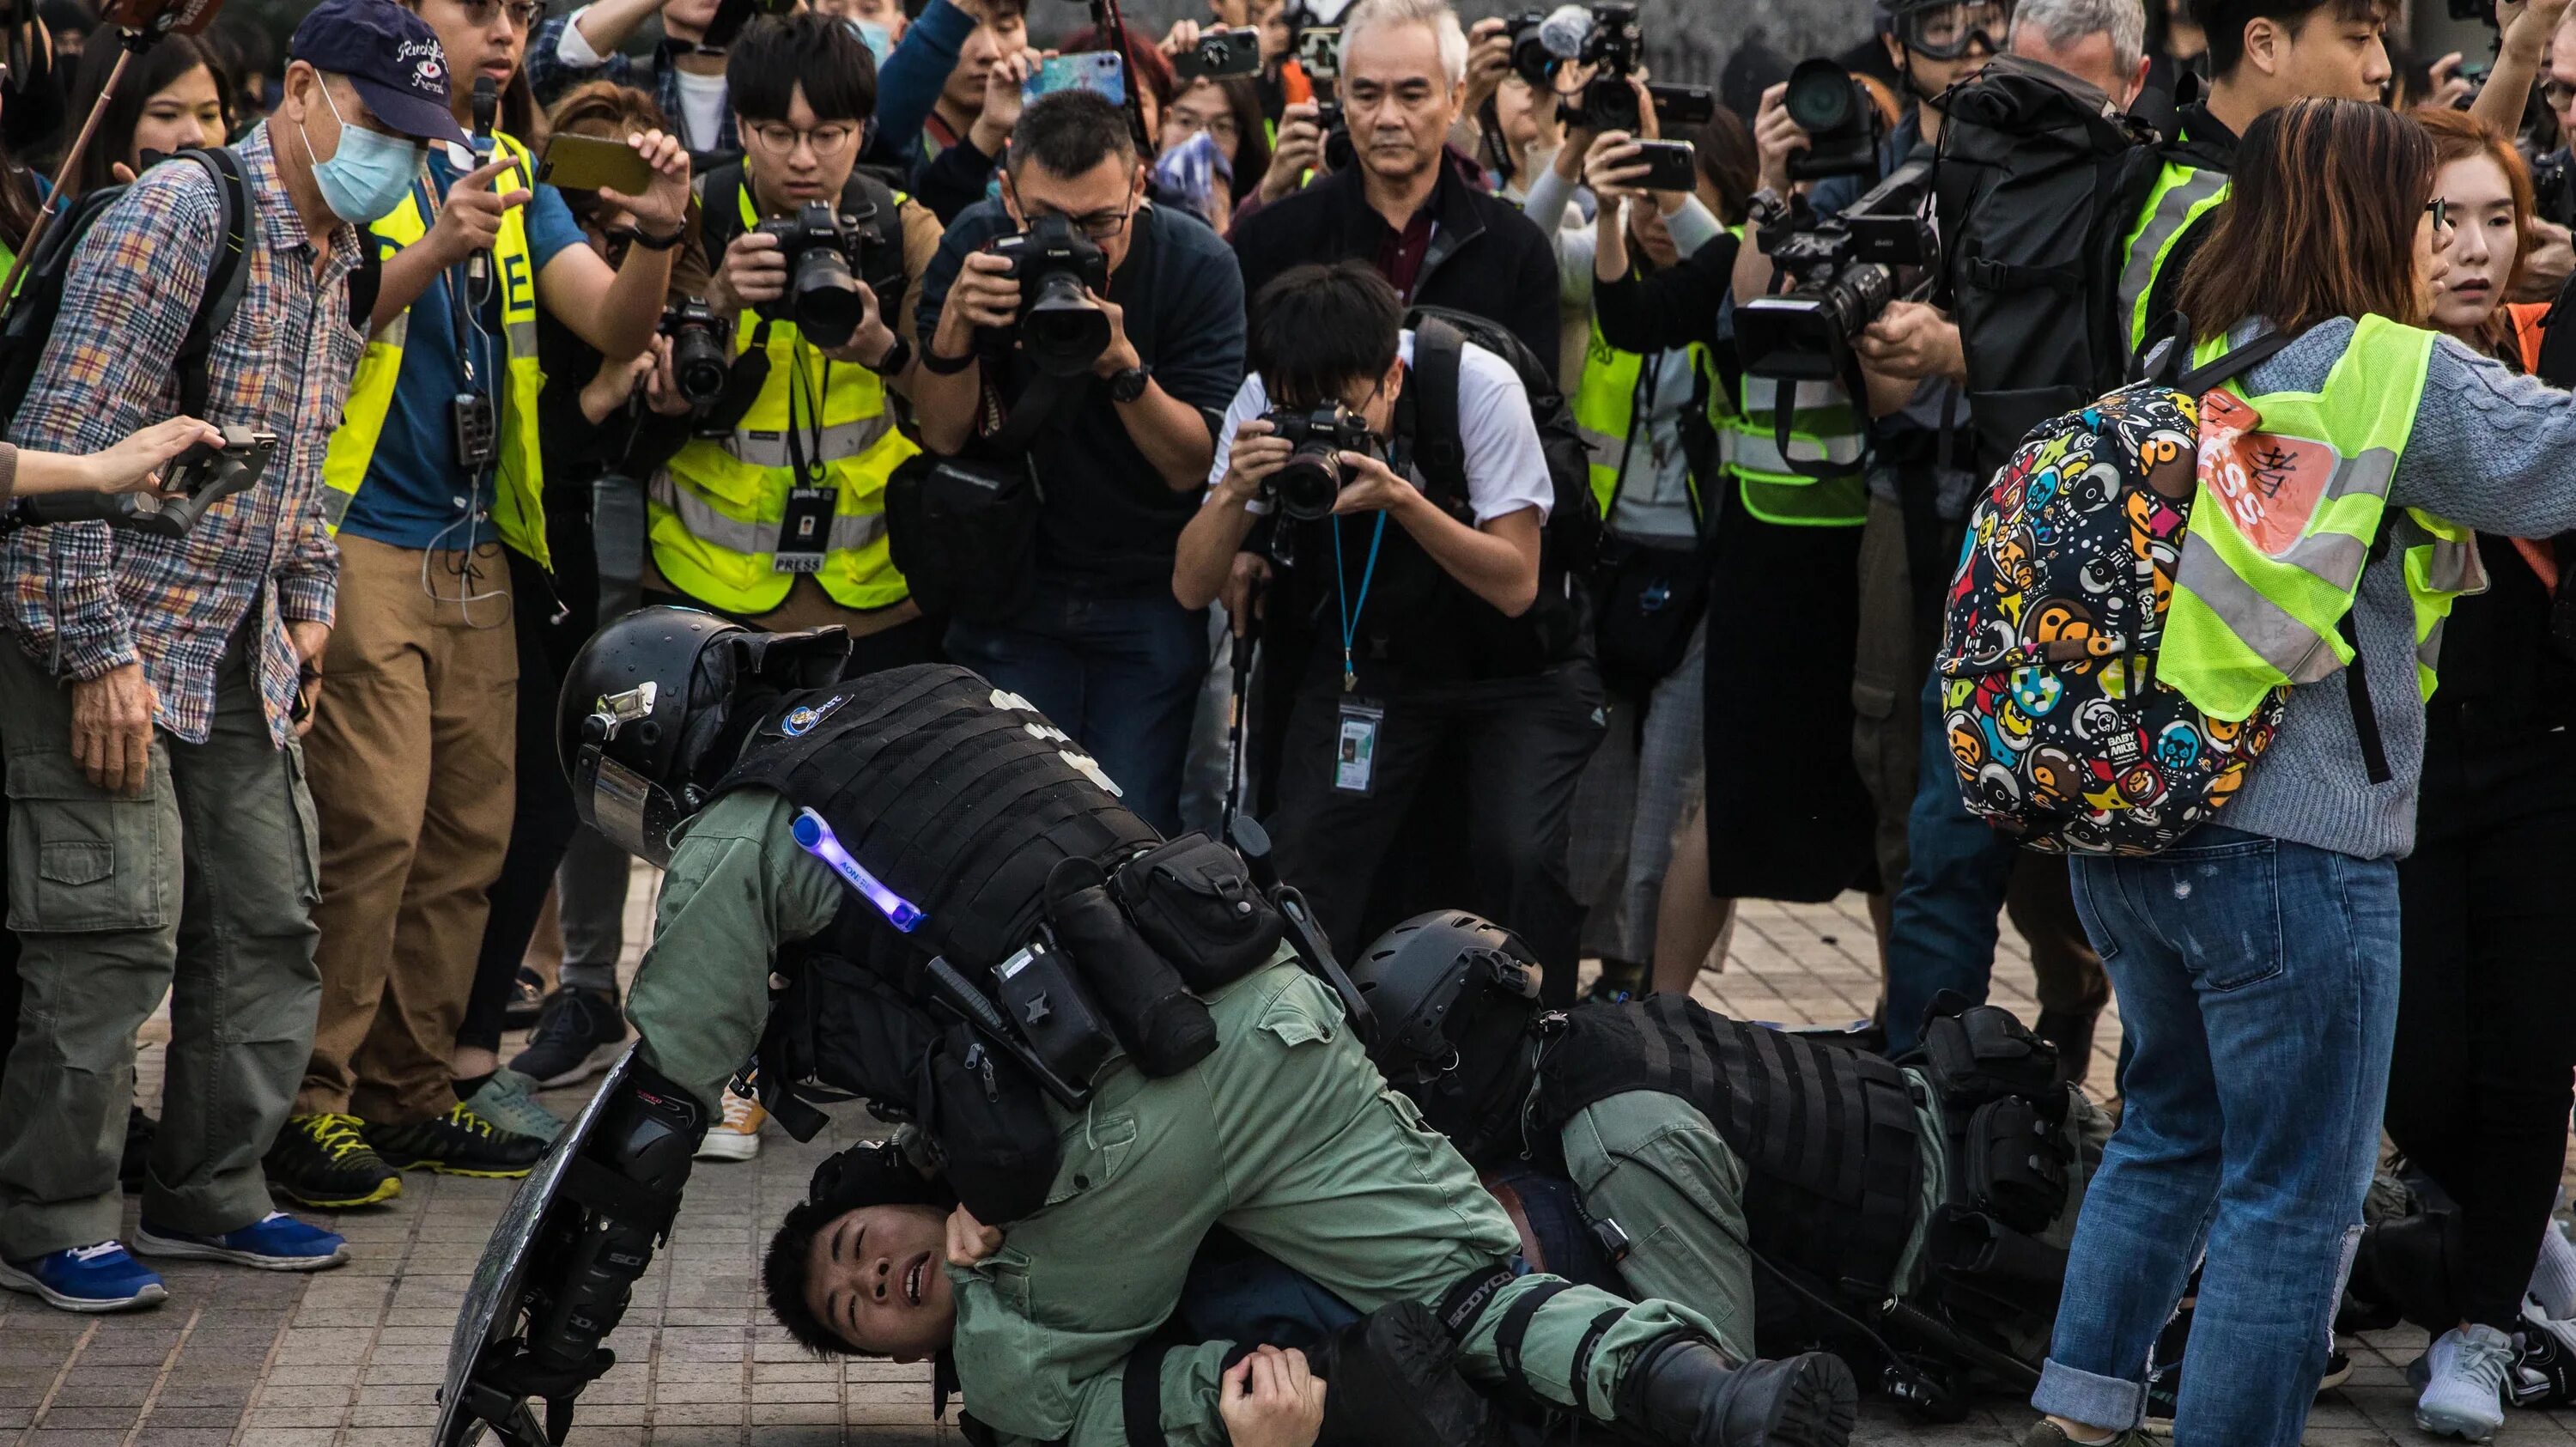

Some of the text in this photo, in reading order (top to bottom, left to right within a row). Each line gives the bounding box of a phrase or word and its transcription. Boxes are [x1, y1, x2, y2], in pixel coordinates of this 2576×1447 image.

[775, 559, 820, 572] PRESS
[2107, 732, 2135, 746] BABY
[1448, 1271, 1514, 1328] SCOYCO
